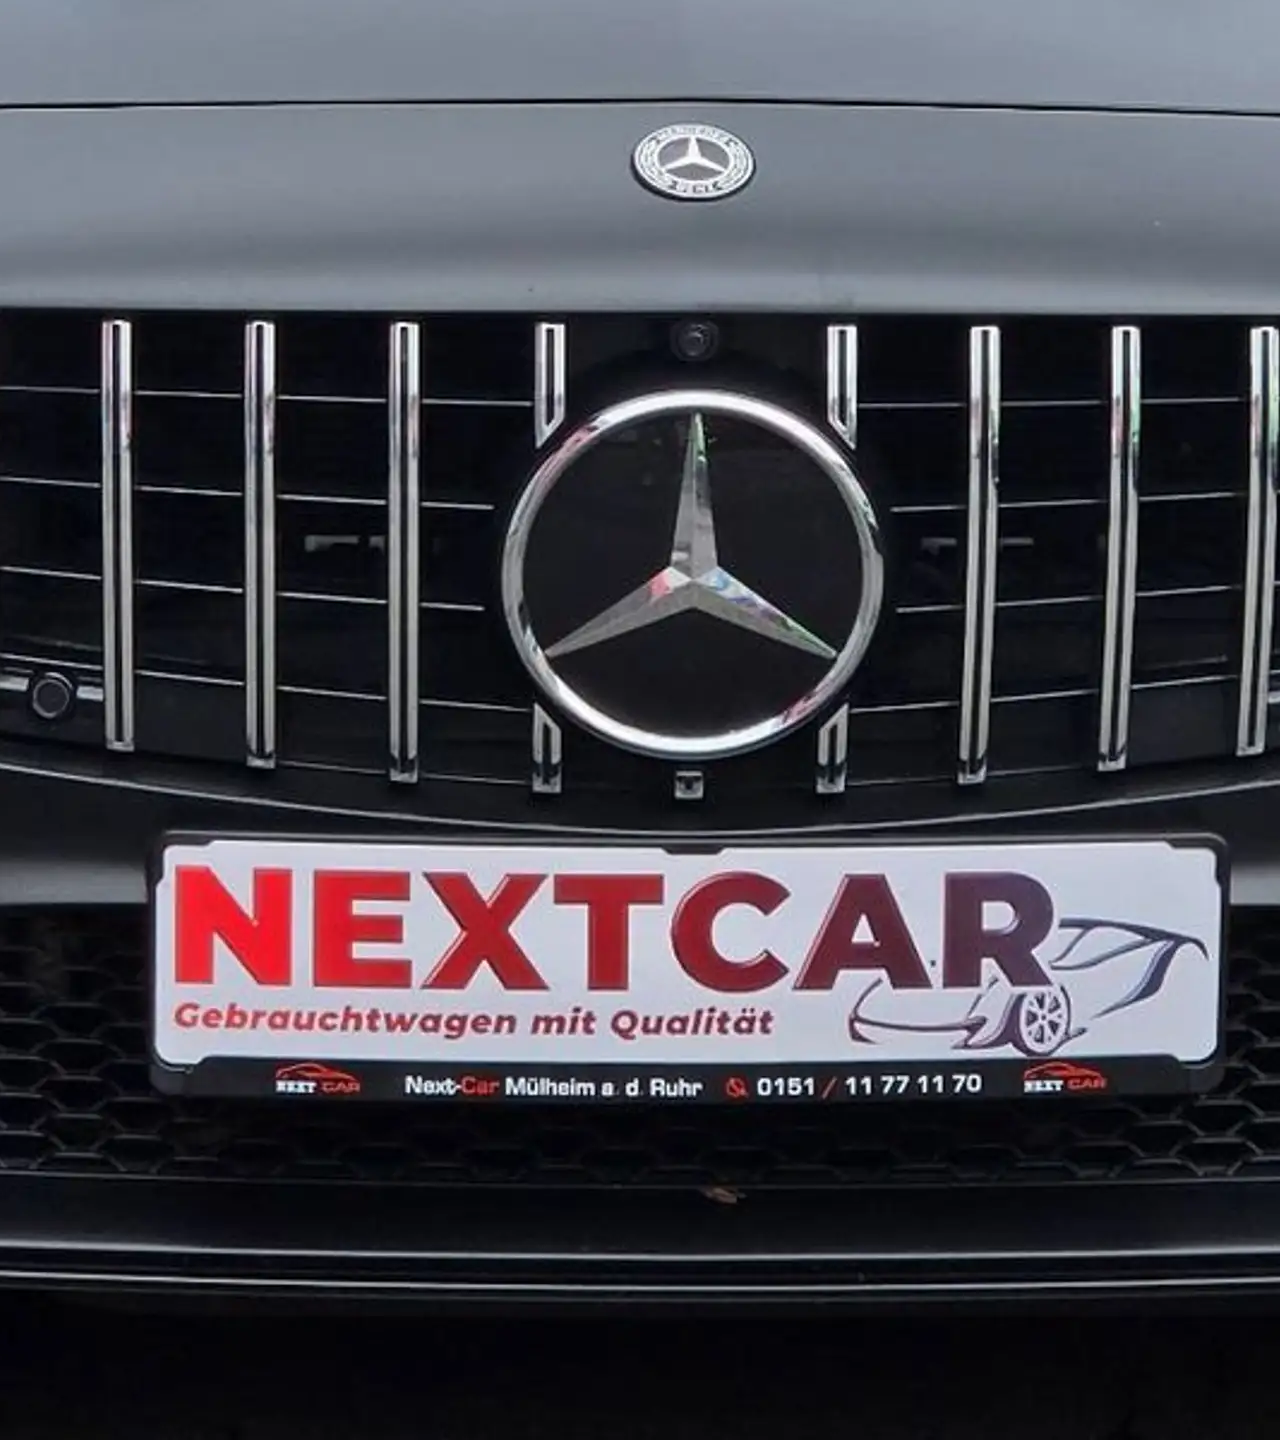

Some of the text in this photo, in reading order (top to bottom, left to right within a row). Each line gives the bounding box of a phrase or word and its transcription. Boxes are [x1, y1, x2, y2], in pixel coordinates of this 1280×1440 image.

[174, 864, 1055, 994] NEXTCAR
[173, 1001, 775, 1040] Gebrauchtwagen mit Qualität
[404, 1075, 500, 1096] Next-Car
[504, 1076, 596, 1097] Mülheim
[649, 1077, 704, 1097] Ruhr
[756, 1076, 816, 1097] 0151
[845, 1075, 873, 1096] 11
[880, 1074, 911, 1095] 77
[918, 1074, 945, 1094] 11
[951, 1073, 983, 1094] 70
